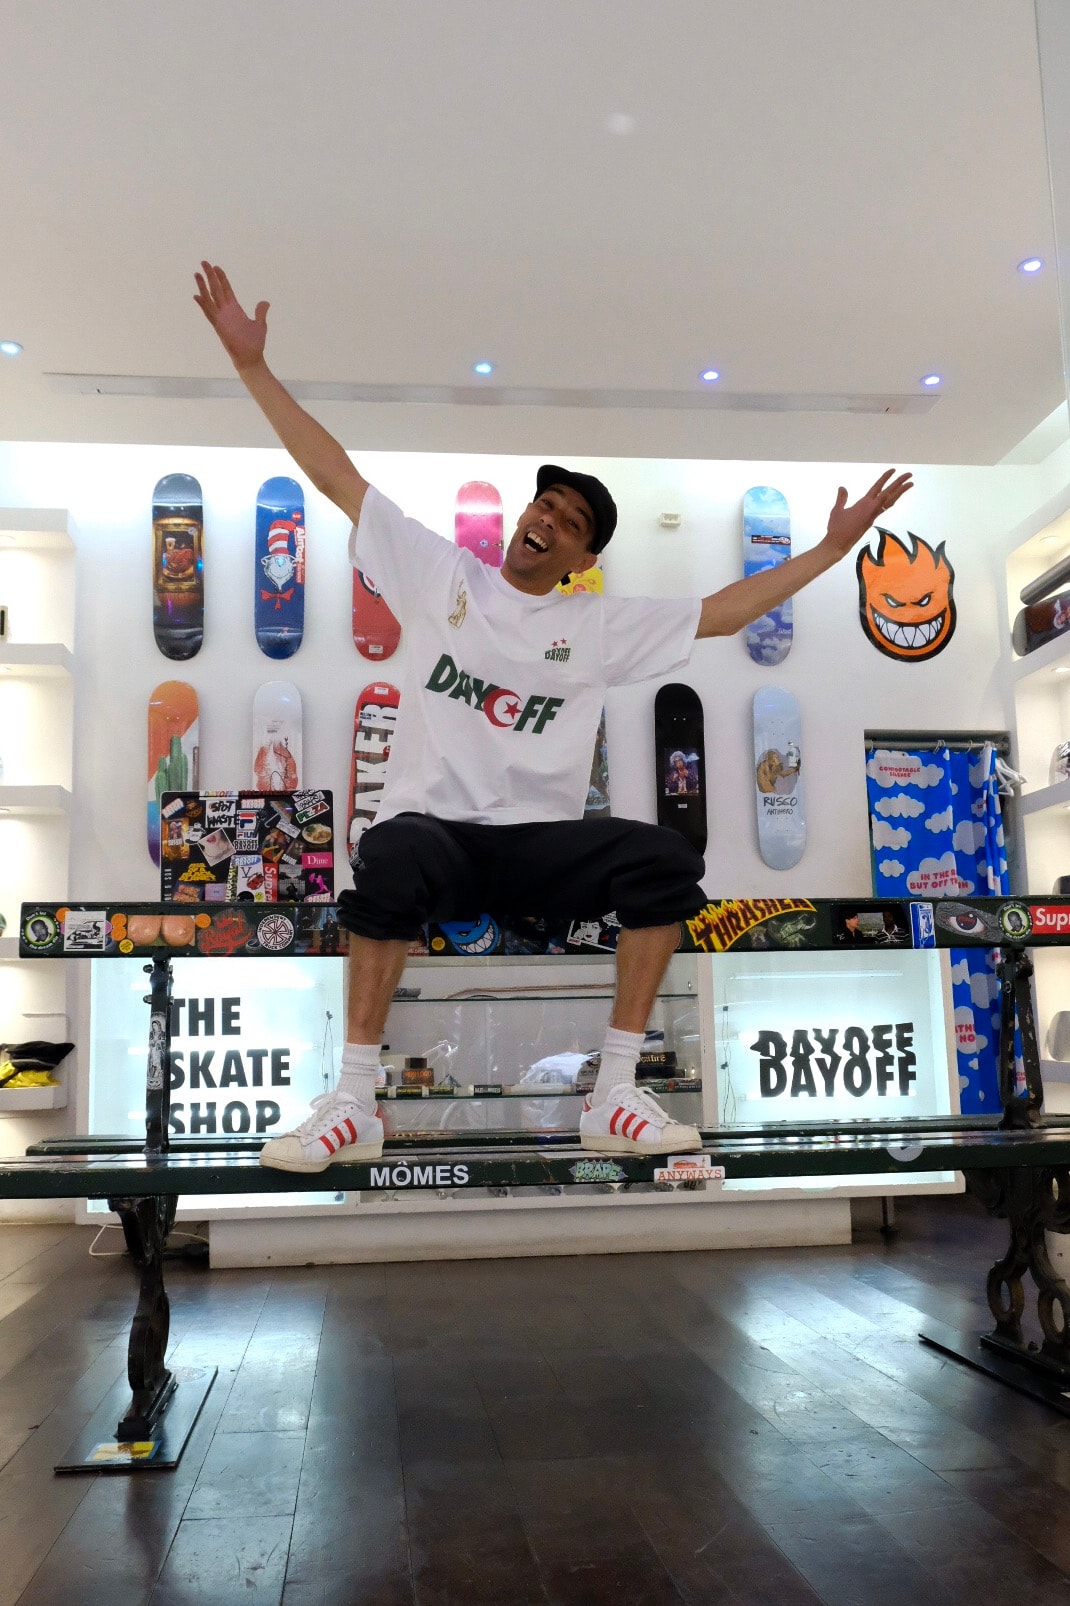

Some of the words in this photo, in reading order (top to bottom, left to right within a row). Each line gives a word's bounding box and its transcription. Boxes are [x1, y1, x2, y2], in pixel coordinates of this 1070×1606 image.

[307, 855, 329, 865] Dime
[933, 870, 949, 879] THE
[1035, 907, 1070, 931] Sup
[170, 997, 241, 1037] THE
[169, 1048, 291, 1090] SKATE
[760, 1055, 917, 1098] DAYOFF
[168, 1100, 281, 1134] SHOP
[658, 1168, 722, 1181] ANYWAYS
